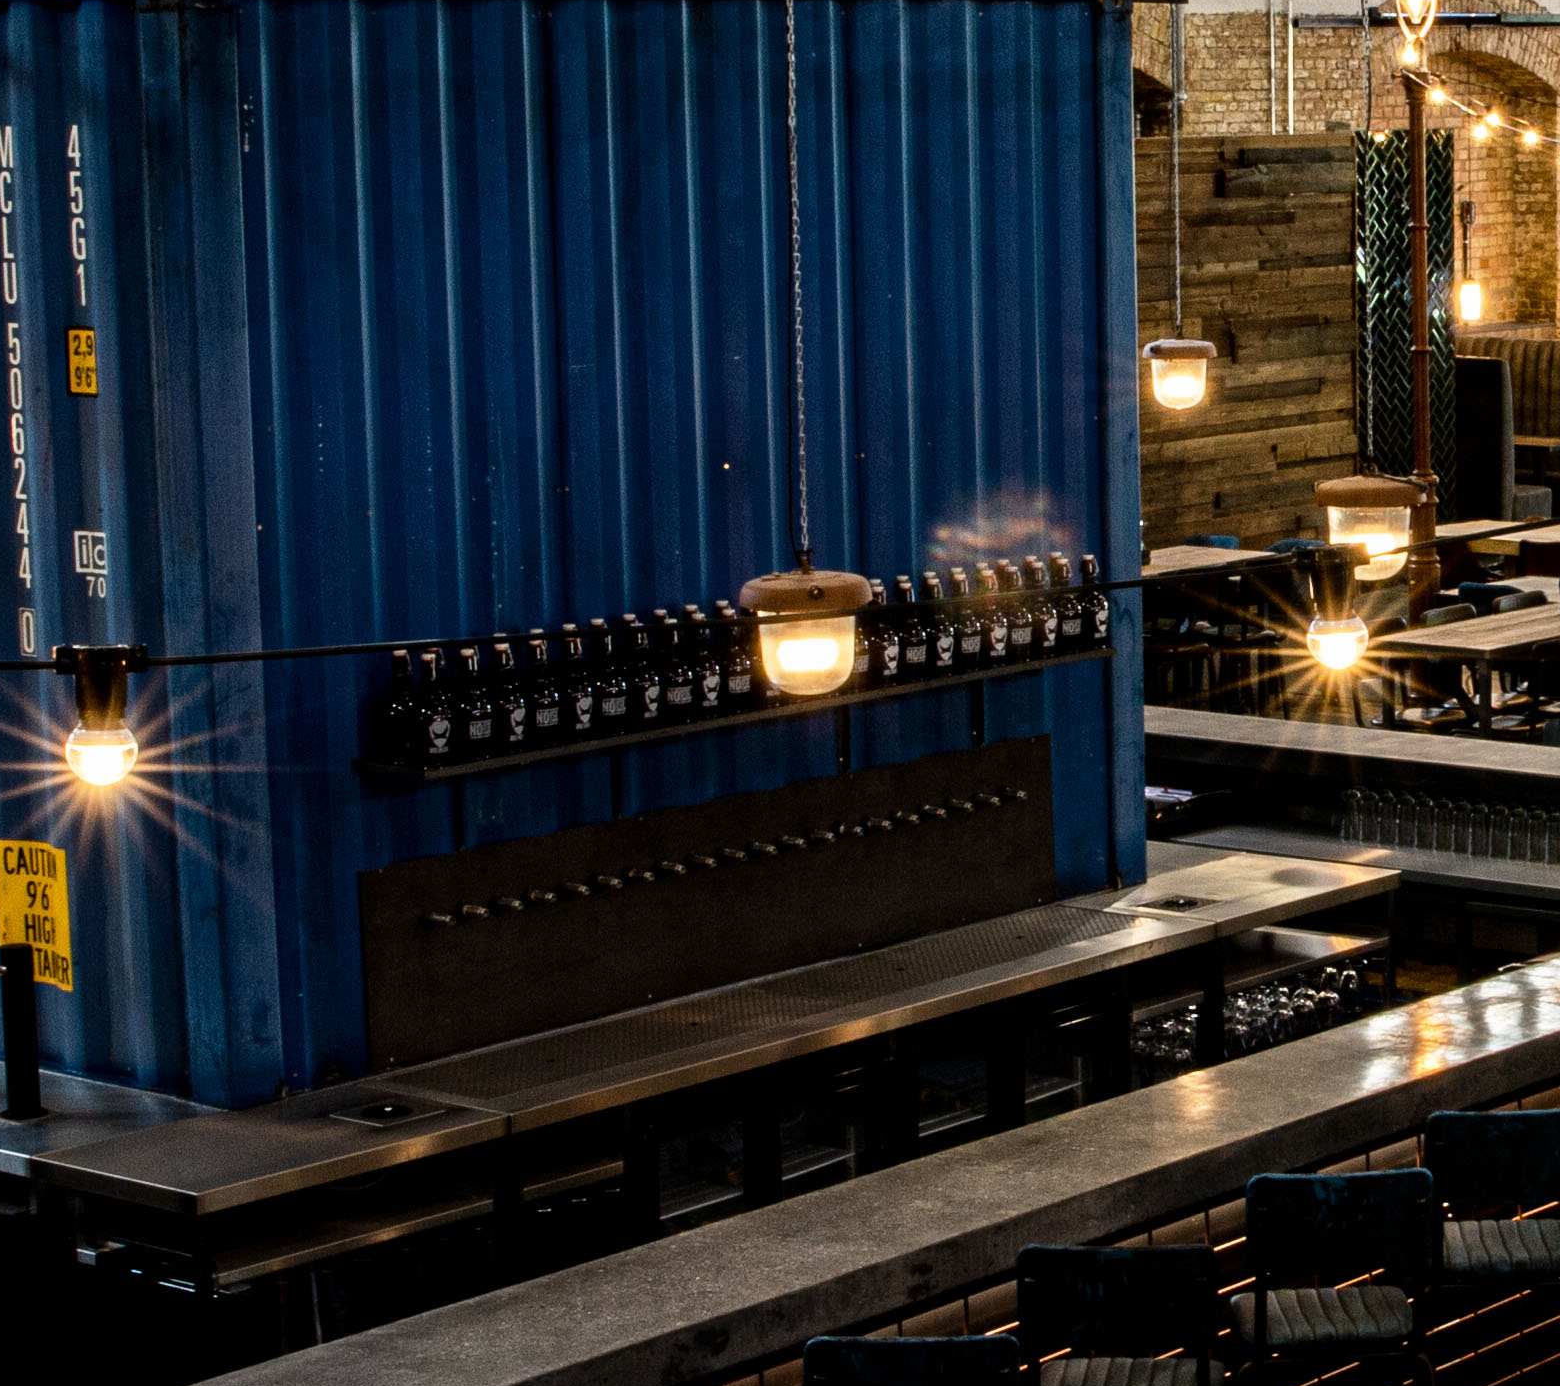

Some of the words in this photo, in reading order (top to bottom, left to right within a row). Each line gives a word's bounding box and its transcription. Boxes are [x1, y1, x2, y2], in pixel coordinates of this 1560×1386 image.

[66, 124, 87, 307] 45G1
[73, 334, 94, 358] 2,9
[7, 322, 33, 590] 506244
[86, 576, 107, 599] 70
